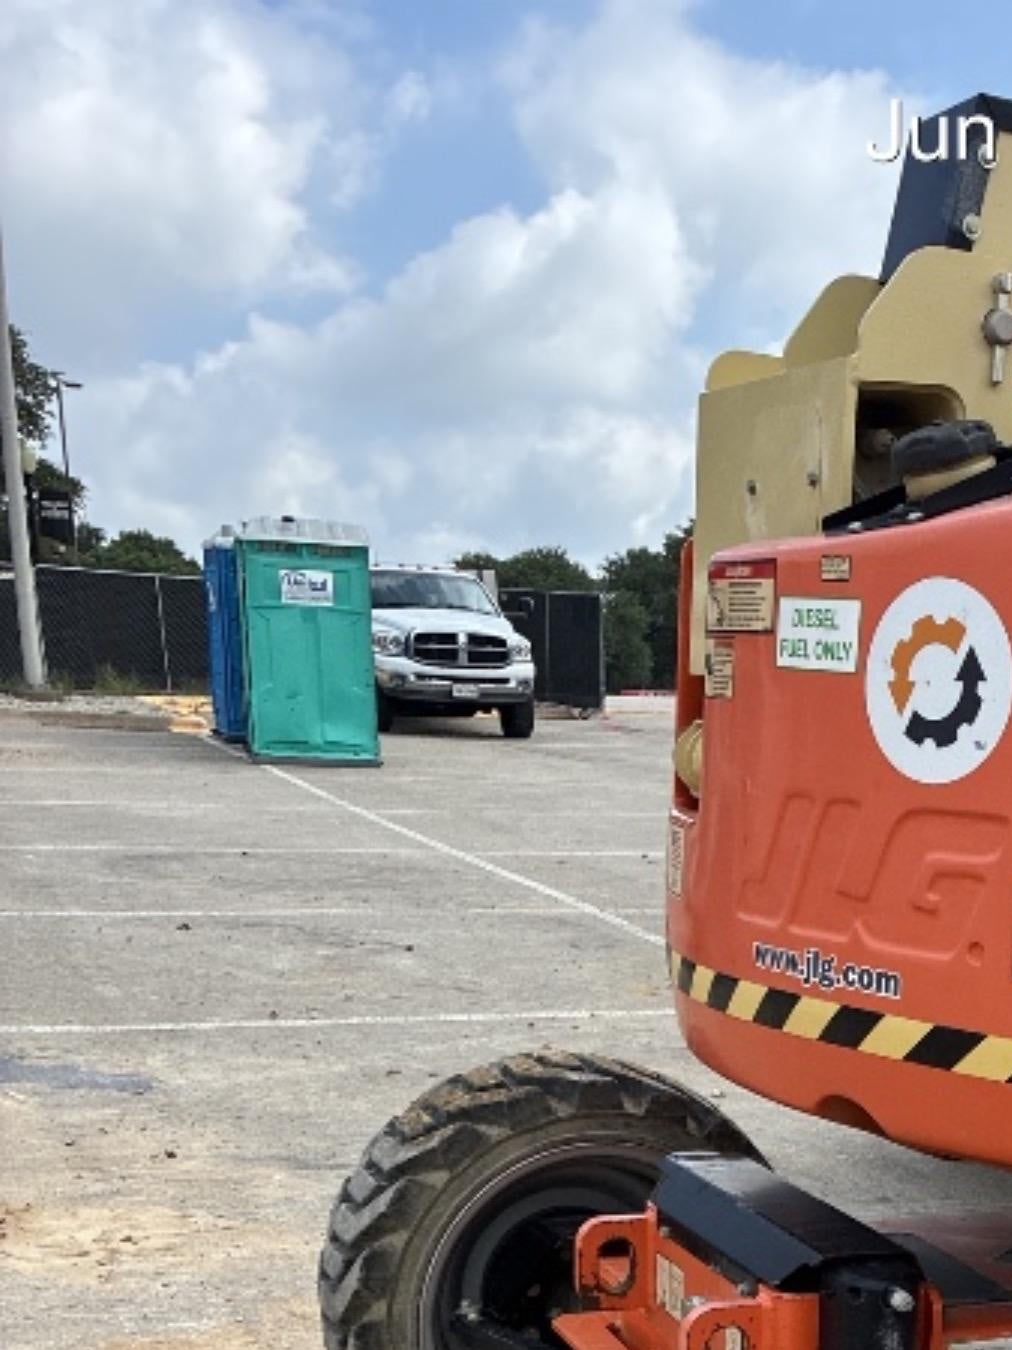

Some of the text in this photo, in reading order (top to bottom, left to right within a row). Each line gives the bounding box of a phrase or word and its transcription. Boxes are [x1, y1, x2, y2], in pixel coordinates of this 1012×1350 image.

[791, 607, 839, 630] DIESEL
[779, 638, 853, 662] FUEL ONLY
[753, 941, 900, 998] www.jlg.com
